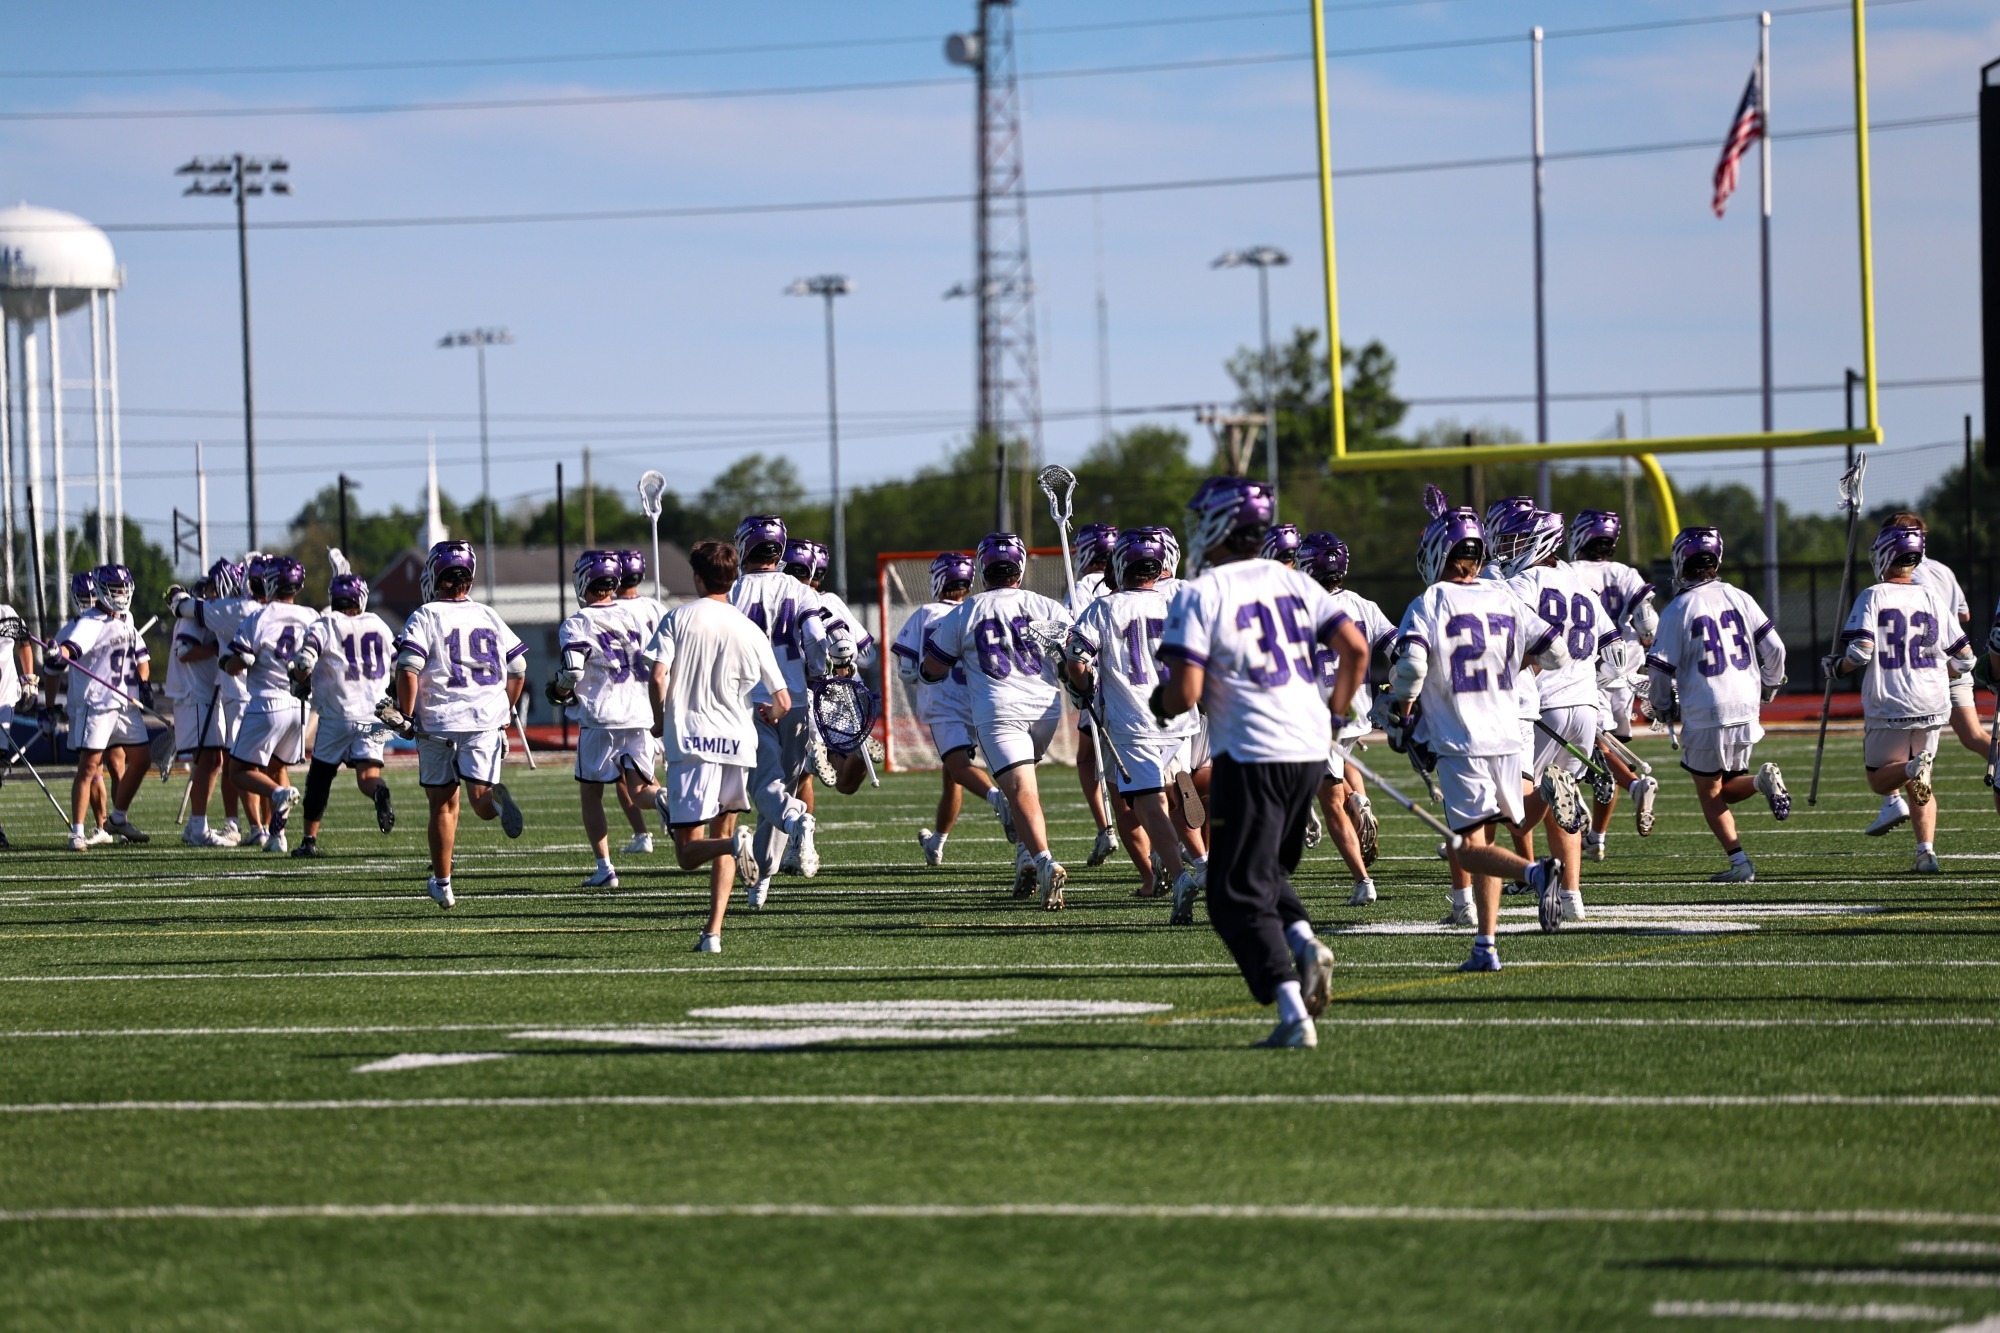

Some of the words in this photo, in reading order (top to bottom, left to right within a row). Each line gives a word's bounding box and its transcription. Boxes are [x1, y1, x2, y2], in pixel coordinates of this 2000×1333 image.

[341, 632, 386, 681] 10
[444, 627, 503, 688] 19
[974, 616, 1042, 680] 66
[1235, 595, 1317, 688] 35
[1445, 612, 1516, 693] 27
[1691, 608, 1752, 678] 33
[1877, 608, 1939, 670] 32
[682, 736, 741, 755] FAMILY
